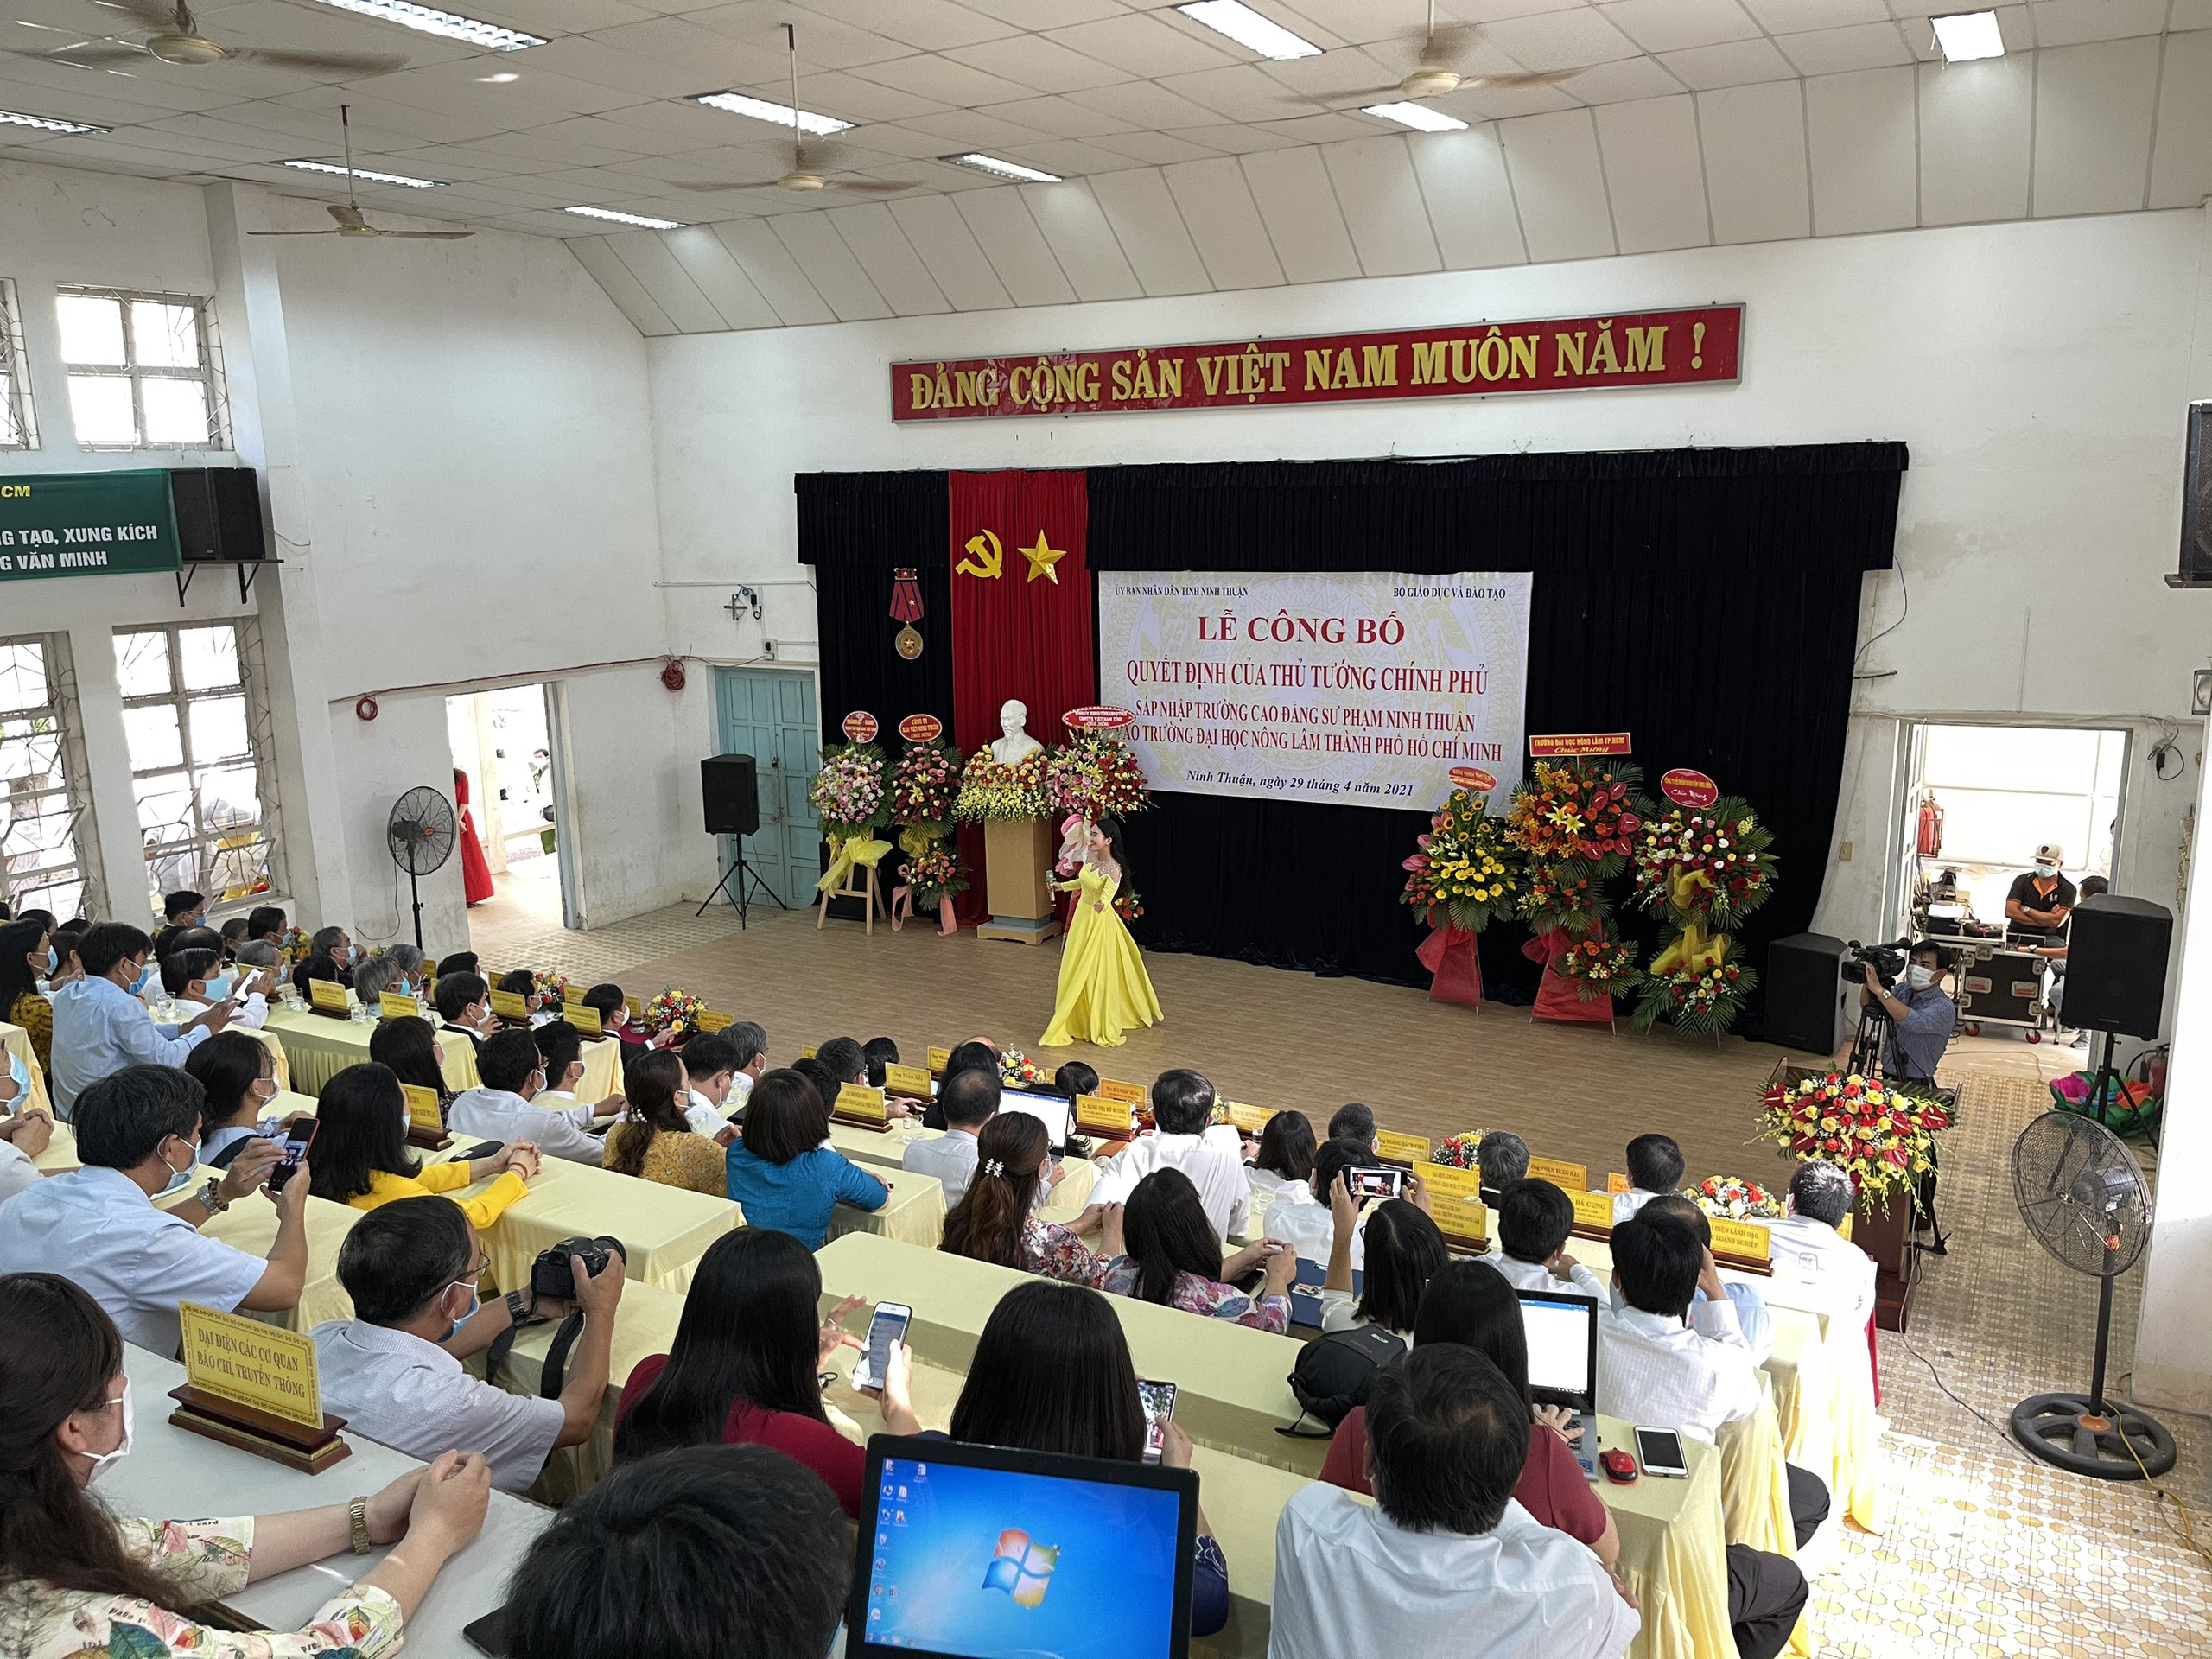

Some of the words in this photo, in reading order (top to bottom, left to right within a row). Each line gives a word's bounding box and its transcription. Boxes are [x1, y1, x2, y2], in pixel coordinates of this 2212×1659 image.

[910, 362, 1000, 410] ĐẢNG
[1009, 355, 1103, 413] CỘNG
[1111, 347, 1184, 401] SẢN
[1196, 343, 1291, 404] VIỆT
[1304, 344, 1399, 391] NAM
[1411, 325, 1540, 384] MUÔN
[1554, 320, 1669, 378] NĂM
[1690, 321, 1706, 370] !
[18, 529, 60, 548] TẠO,
[63, 527, 113, 543] XUNG
[118, 523, 158, 542] KÍCH
[16, 551, 55, 570] VĂN
[60, 550, 108, 568] MINH
[1126, 586, 1141, 596] BAN
[1141, 584, 1163, 596] NHÂN
[1164, 584, 1180, 596] DÂN
[1200, 587, 1220, 597] NINH
[1221, 585, 1249, 599] THUẬN
[1393, 586, 1406, 600] BỘ
[1407, 584, 1430, 598] GIÁO
[1431, 587, 1451, 600] DỤC
[1452, 585, 1464, 599] VÀ
[1465, 585, 1485, 599] ĐÀO
[1487, 588, 1506, 601] TẠO
[1197, 608, 1238, 642] LỄ
[1247, 608, 1346, 644] CÔNG
[1356, 610, 1406, 645] BỐ
[1127, 654, 1182, 687] QUYẾT
[1185, 661, 1227, 690] ĐỊNH
[1230, 656, 1267, 686] CỦA
[1269, 658, 1306, 688] THỦ
[1310, 659, 1376, 690] TƯỚNG
[1381, 660, 1443, 692] CHÍNH
[1448, 663, 1489, 695] PHỦ
[1135, 695, 1158, 717] SÁP
[1160, 698, 1192, 722] NHẬP
[1194, 697, 1249, 722] TRƯỜNG
[1251, 704, 1279, 722] CAO
[1321, 704, 1341, 726] SƯ
[1343, 708, 1382, 732] PHẠM
[1386, 709, 1422, 729] NINH
[1425, 710, 1476, 737] THUẬN
[1141, 721, 1194, 744] TRƯỜNG
[1196, 728, 1218, 749] ĐẠI
[1221, 728, 1248, 751] HỌC
[1251, 726, 1288, 749] NÔNG
[1291, 728, 1320, 751] LÂM
[1324, 730, 1371, 754] THÀNH
[1375, 734, 1404, 756] PHỐ
[1408, 734, 1429, 757] HỒ
[1432, 734, 1458, 759] CHÍ
[1461, 741, 1503, 762] MINH
[1186, 770, 1214, 782] Ninh
[1217, 772, 1256, 787] Thuận,
[1259, 776, 1287, 790] ngày
[1289, 778, 1305, 788] 29
[1306, 779, 1340, 794] tháng
[1343, 783, 1351, 792] 4
[1354, 782, 1381, 794] năm
[1383, 783, 1414, 796] 2021
[1586, 1201, 1605, 1210] CUNG
[198, 1328, 215, 1348] ĐẠI
[215, 1332, 238, 1355] DIỆN
[238, 1339, 257, 1359] CÁC
[258, 1347, 271, 1363] CƠ
[273, 1351, 299, 1372] QUAN
[197, 1347, 215, 1370] BÁO
[217, 1354, 235, 1378] CHÍ,
[235, 1363, 272, 1388] TRUYỀN
[273, 1375, 305, 1399] THÔNG
